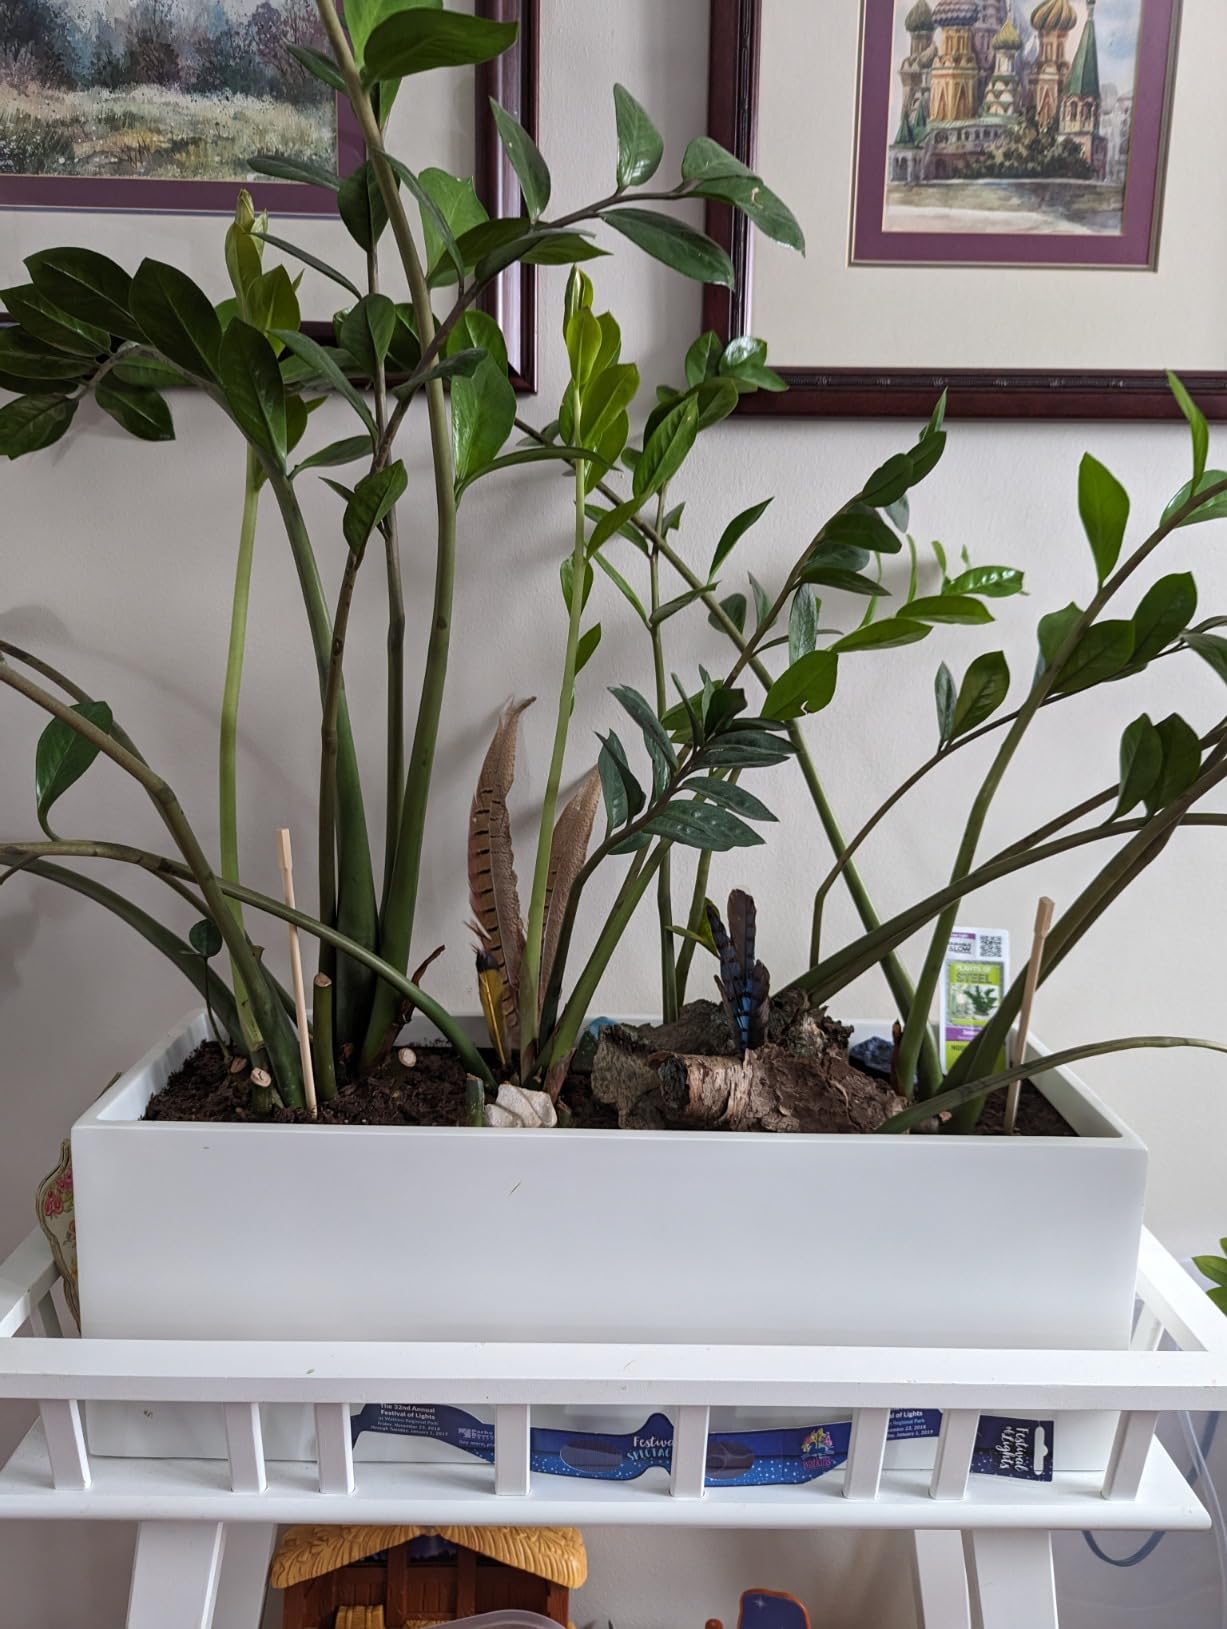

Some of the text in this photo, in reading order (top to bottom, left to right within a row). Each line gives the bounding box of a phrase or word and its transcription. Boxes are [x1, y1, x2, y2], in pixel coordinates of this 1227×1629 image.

[956, 973, 993, 984] STEEL
[380, 1409, 407, 1417] Festival
[412, 1405, 436, 1413] Annual
[903, 1410, 923, 1418] Lights
[995, 1433, 1015, 1469] Lights
[1012, 1427, 1030, 1472] Festival
